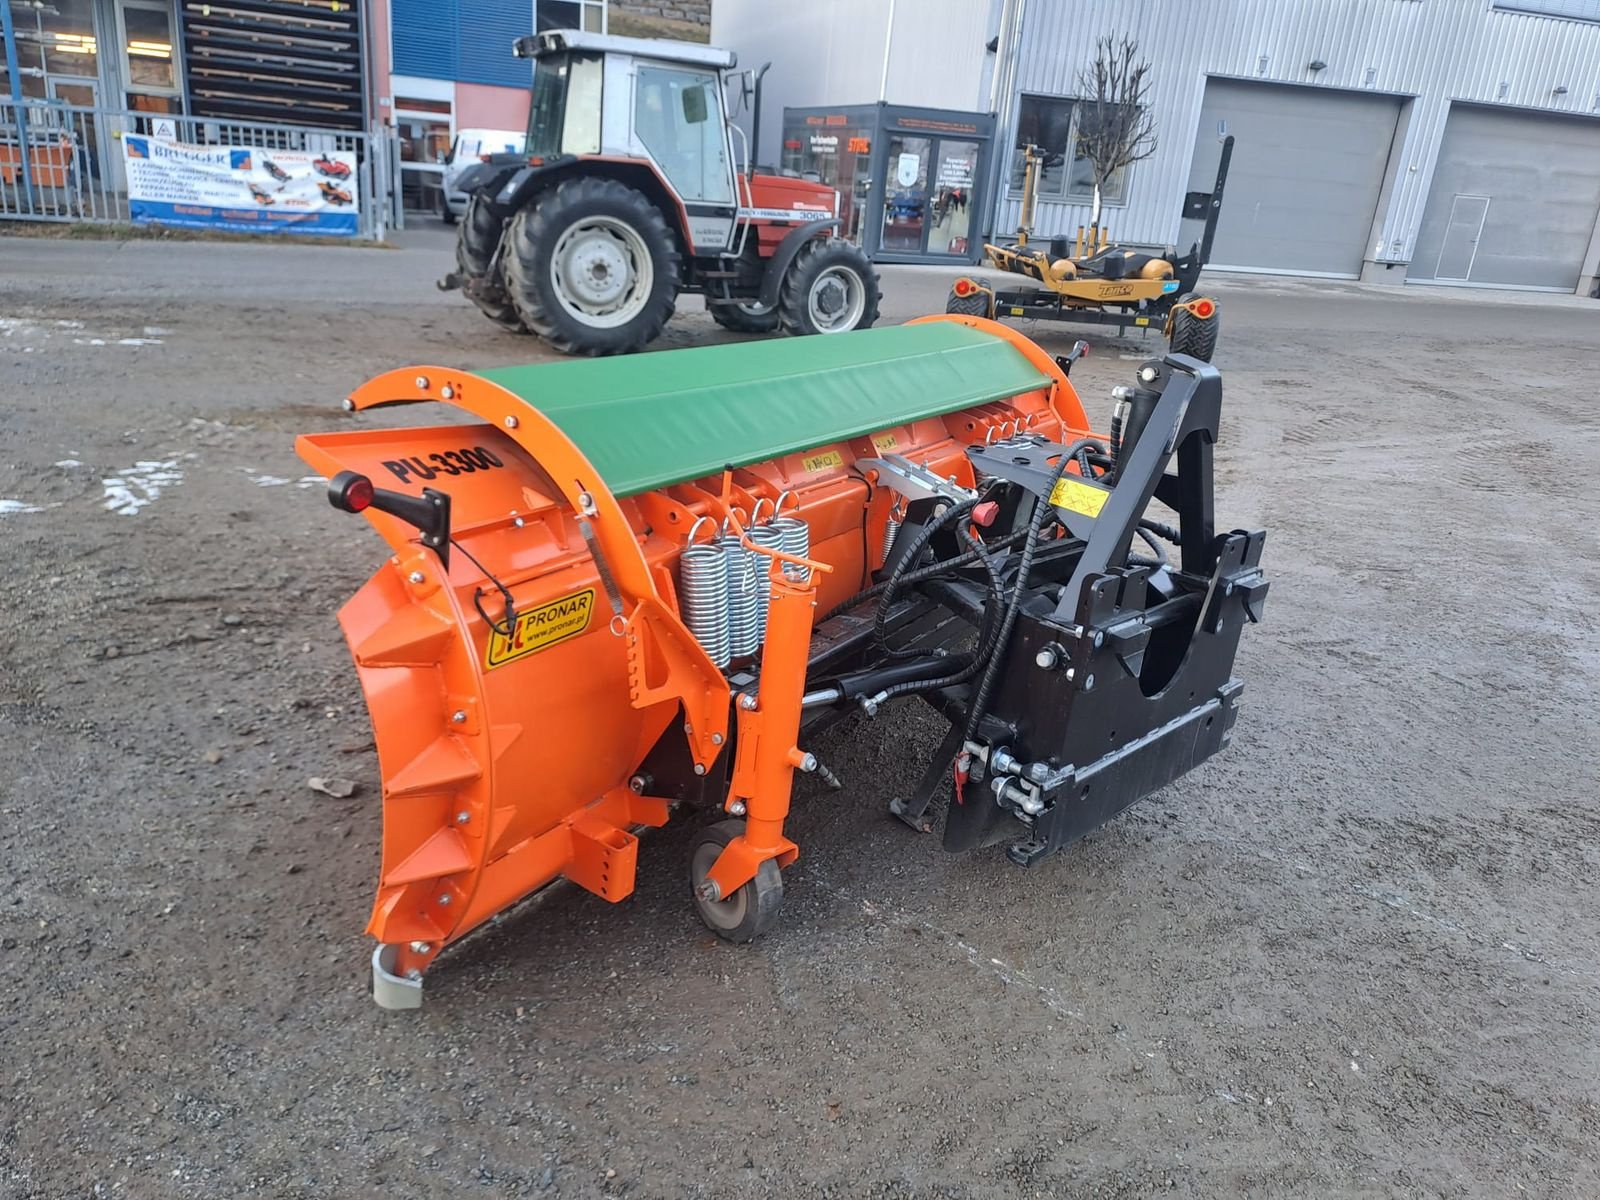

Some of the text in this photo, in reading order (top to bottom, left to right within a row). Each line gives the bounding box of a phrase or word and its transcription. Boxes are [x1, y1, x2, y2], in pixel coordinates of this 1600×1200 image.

[800, 211, 826, 221] 3065
[381, 446, 504, 484] PU-3300
[525, 596, 588, 631] PRONAR
[526, 614, 586, 642] www.pronar.pl
